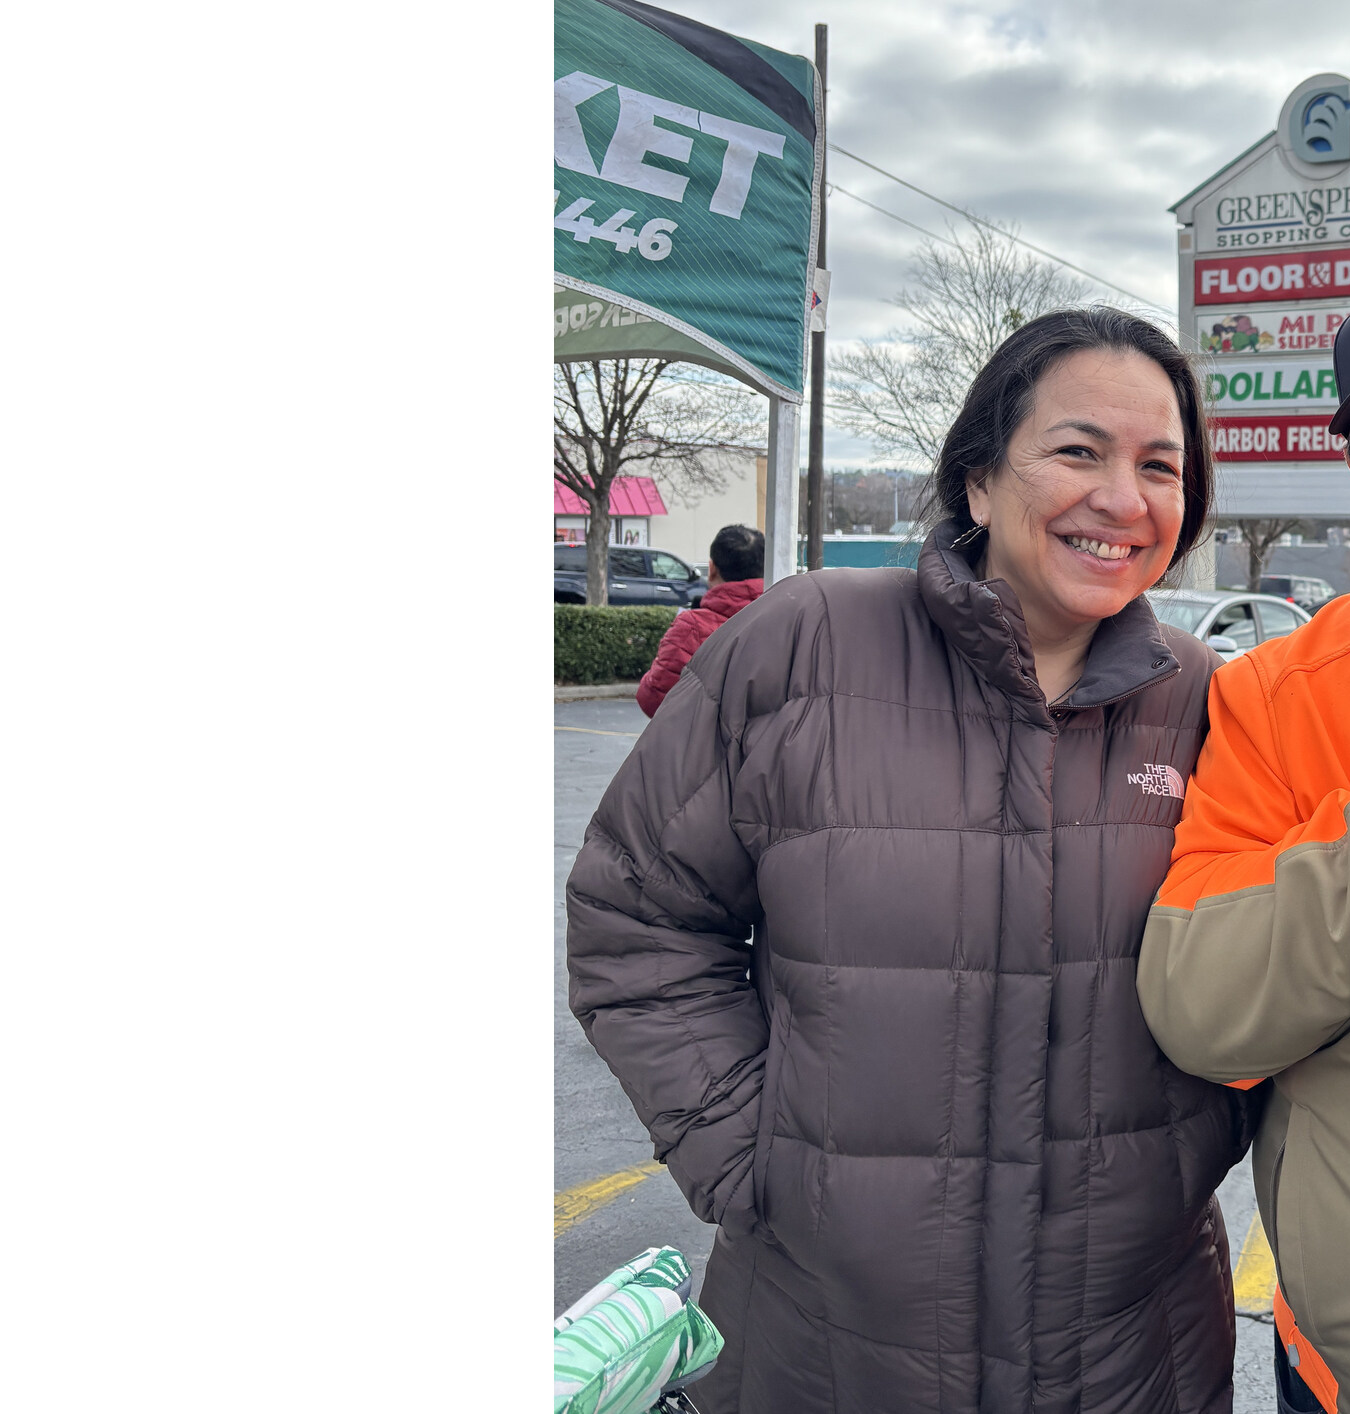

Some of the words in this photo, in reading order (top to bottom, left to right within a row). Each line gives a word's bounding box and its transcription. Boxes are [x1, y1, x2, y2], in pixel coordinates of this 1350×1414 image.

[554, 189, 679, 261] 446
[1217, 226, 1328, 248] SHOPPING
[1201, 263, 1304, 295] FLOOR
[1308, 262, 1331, 288] &
[1278, 315, 1315, 335] MI
[1325, 312, 1350, 333] P
[1278, 334, 1336, 350] SUPE
[1205, 368, 1338, 402] DOLLAR
[1127, 773, 1168, 785] NORTH
[1144, 763, 1167, 774] THE
[1142, 783, 1170, 796] FACE
